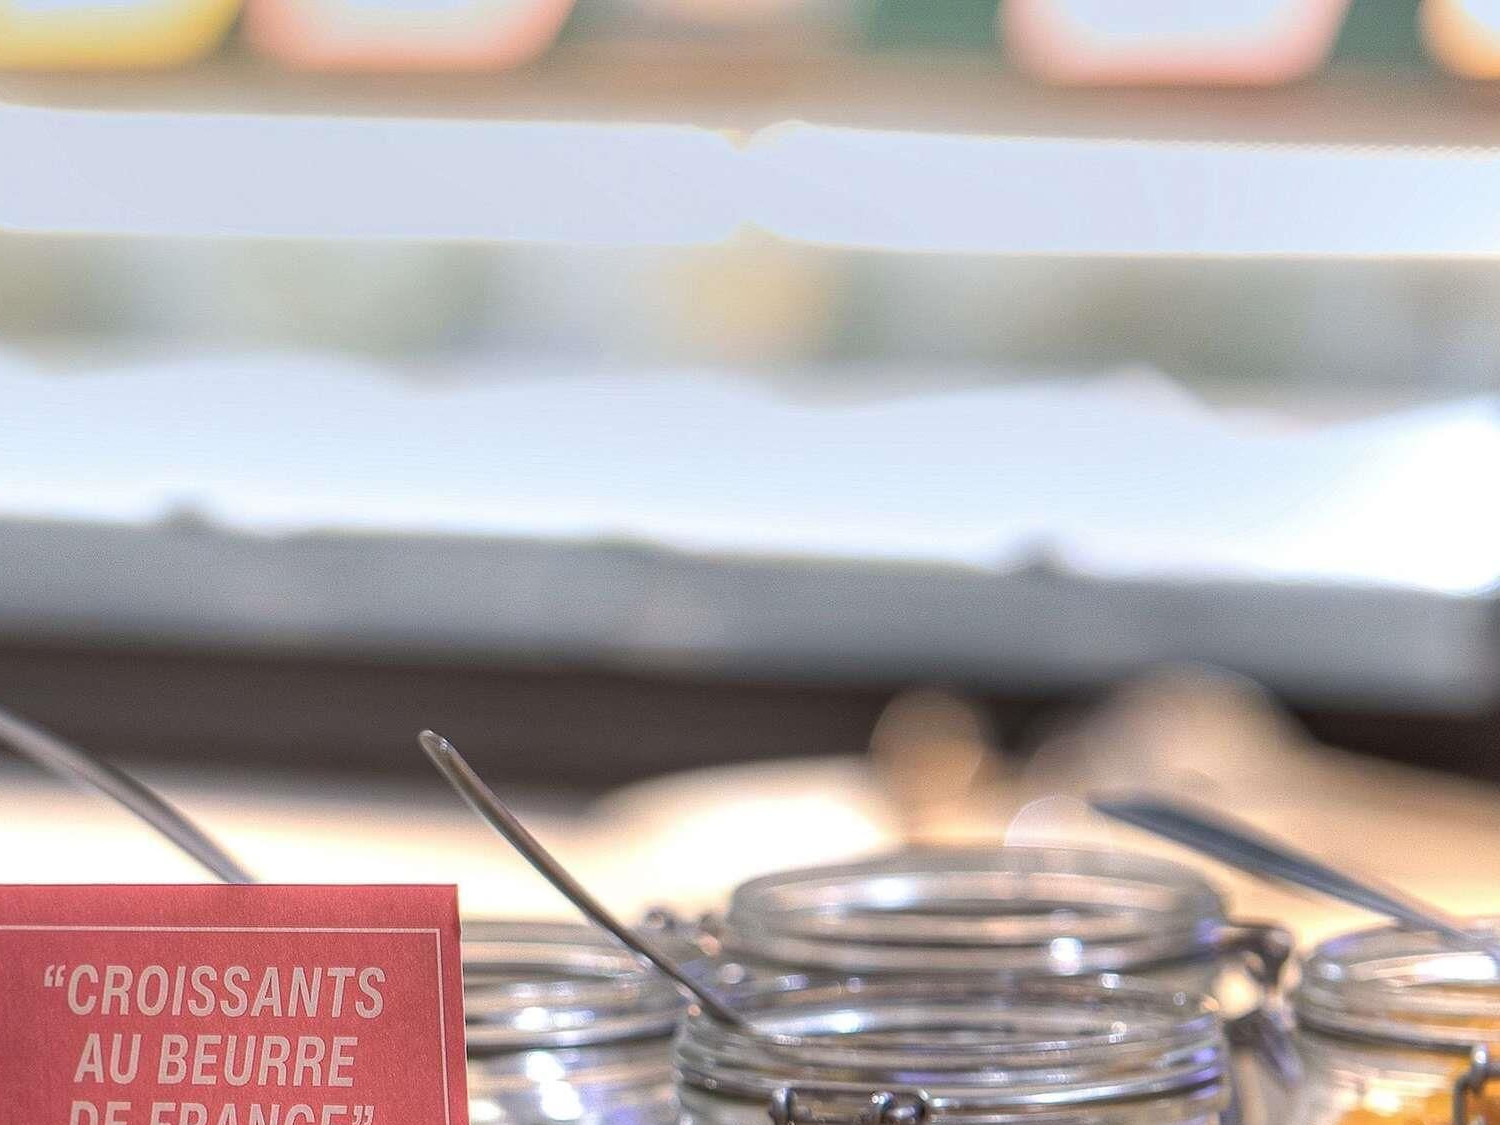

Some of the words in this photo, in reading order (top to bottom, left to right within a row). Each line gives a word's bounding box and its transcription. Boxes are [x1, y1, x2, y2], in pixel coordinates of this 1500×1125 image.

[43, 964, 386, 1019] “CROISSANTS
[73, 1033, 141, 1084] AU
[157, 1035, 358, 1088] BEURRE
